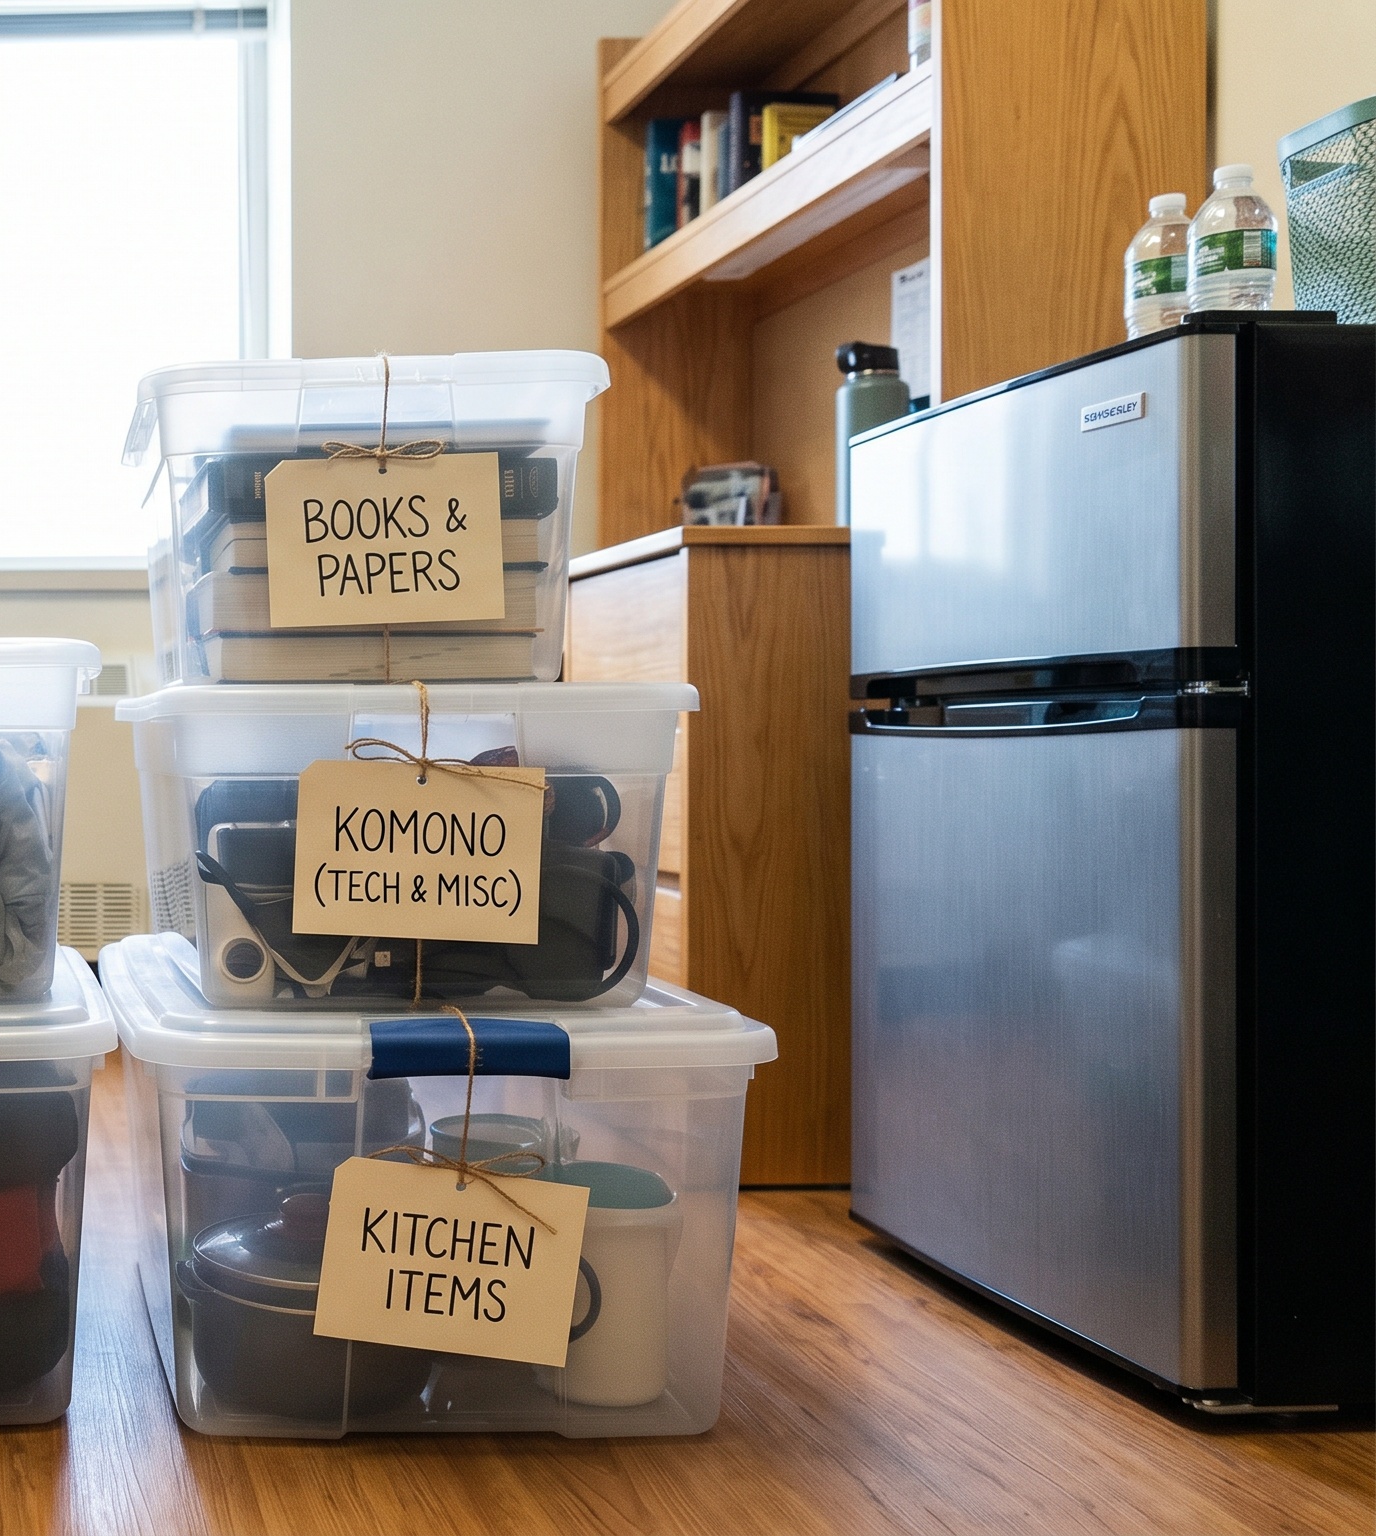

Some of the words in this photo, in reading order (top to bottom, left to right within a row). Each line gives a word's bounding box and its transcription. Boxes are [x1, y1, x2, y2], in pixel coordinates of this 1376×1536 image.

[302, 494, 430, 544] BOOKS
[445, 496, 468, 533] &
[317, 548, 461, 597] PAPERS
[335, 805, 507, 857] KOMONO
[314, 862, 400, 908] (TECH
[410, 874, 428, 903] &
[437, 868, 522, 917] MISC)
[361, 1207, 535, 1269] KITCHEN
[385, 1268, 507, 1323] ITEMS
